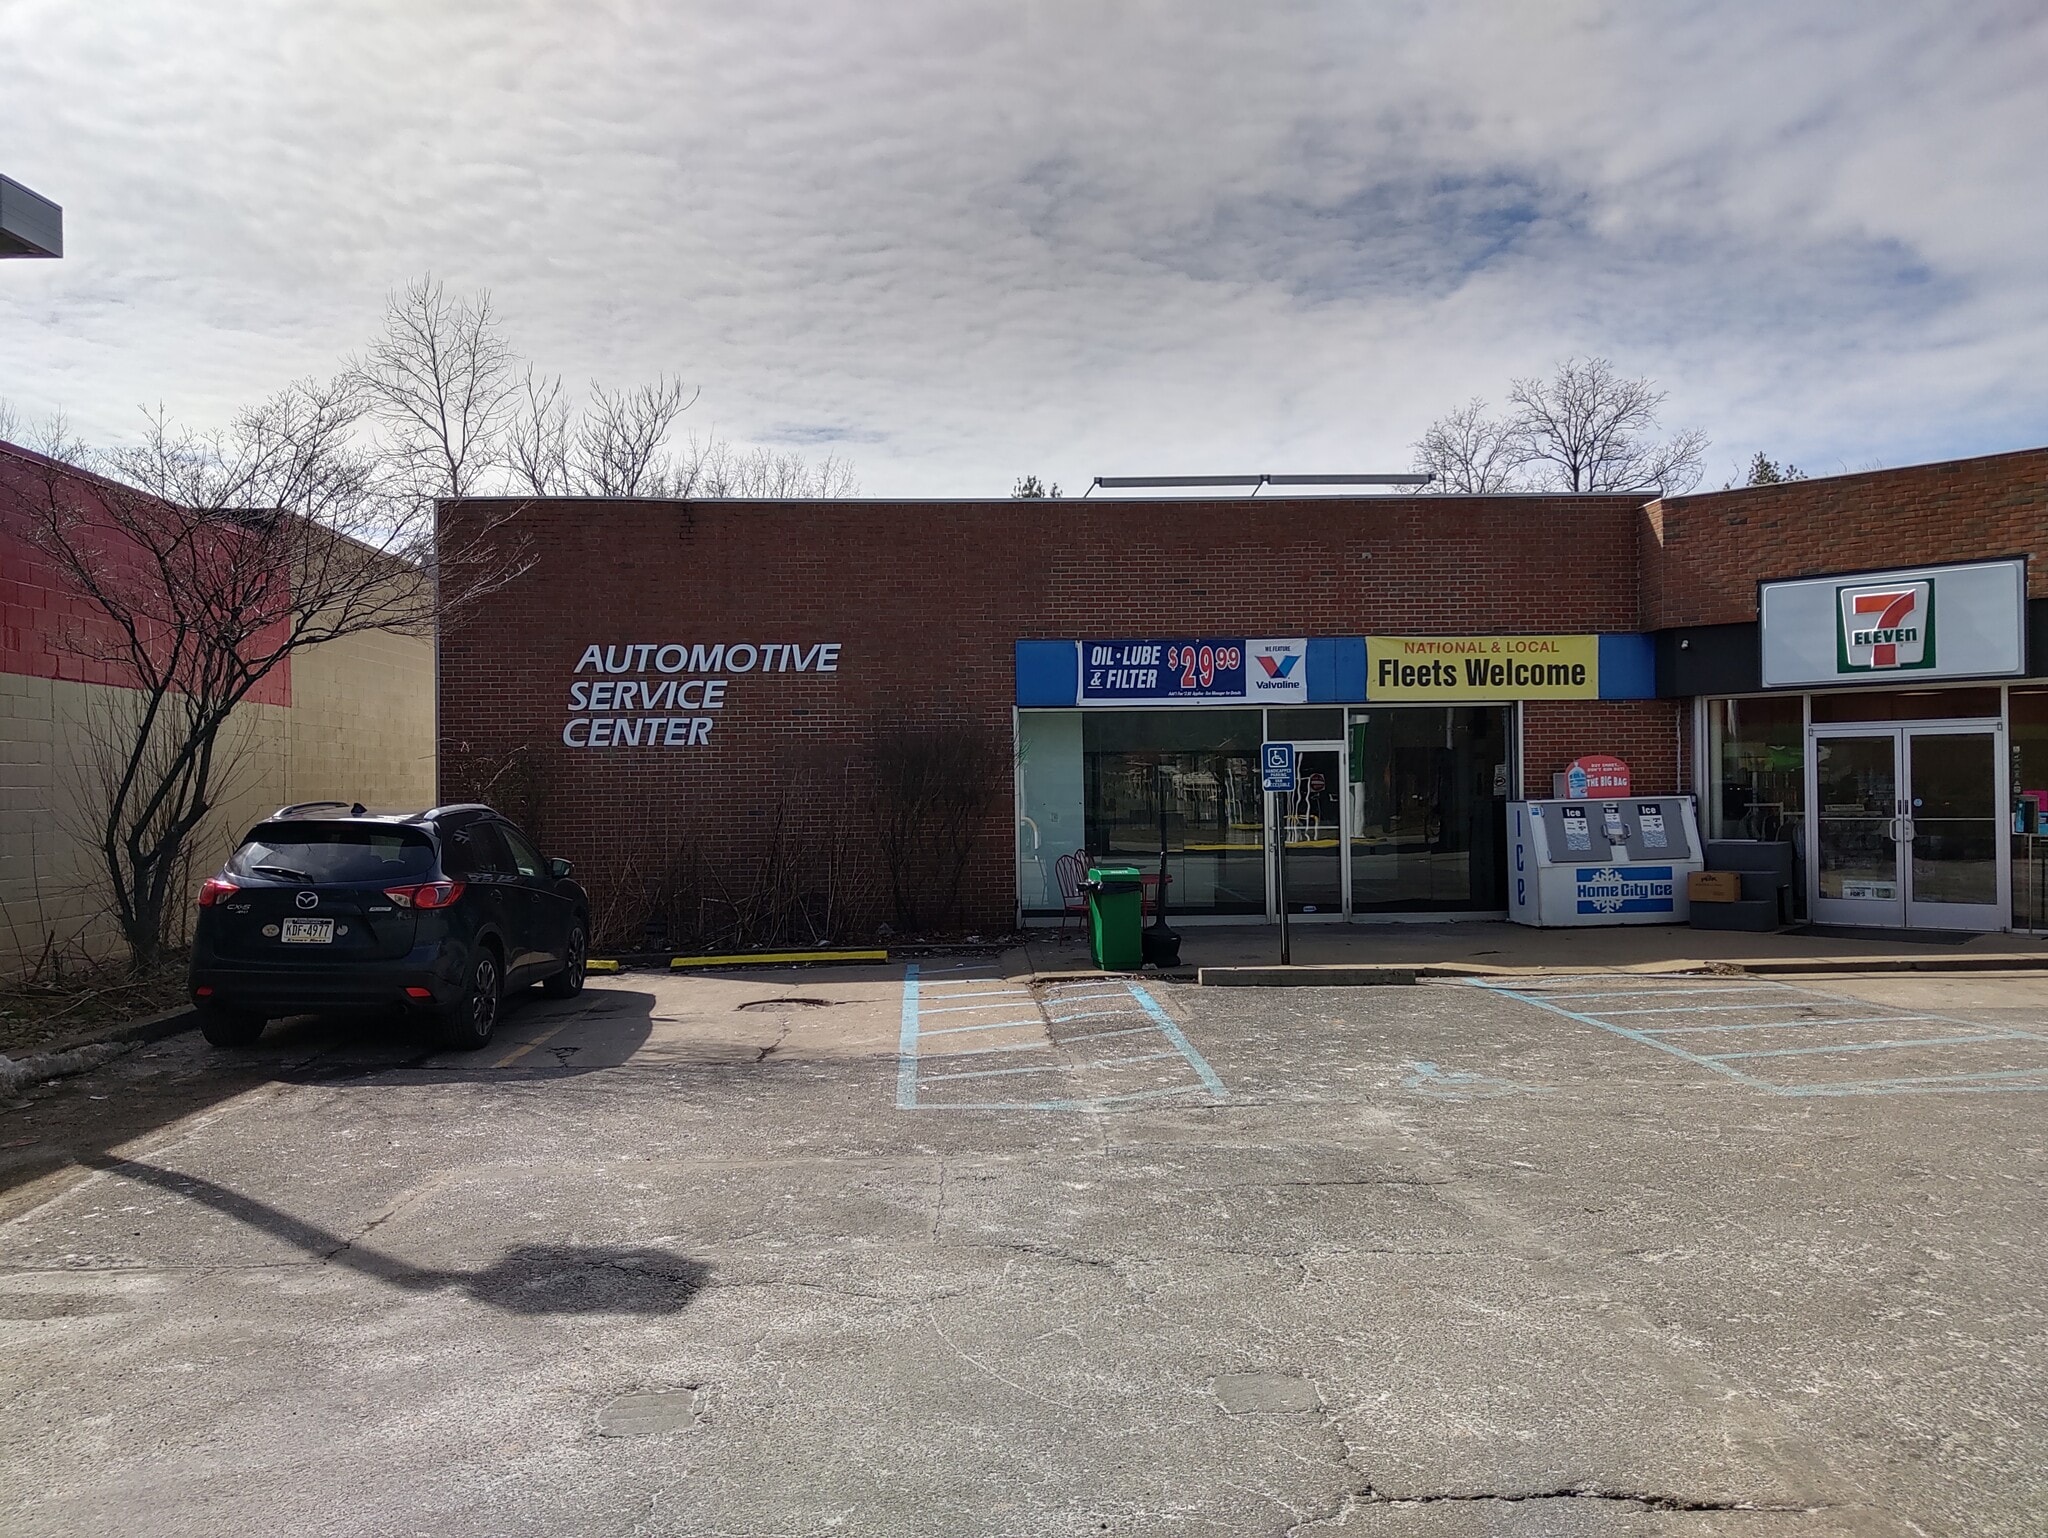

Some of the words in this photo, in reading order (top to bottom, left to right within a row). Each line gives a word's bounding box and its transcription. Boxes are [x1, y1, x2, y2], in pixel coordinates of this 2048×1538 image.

[1853, 588, 1917, 668] 7
[1404, 641, 1487, 654] NATIONAL
[1491, 641, 1501, 653] &
[1506, 640, 1560, 653] LOCAL
[573, 643, 842, 674] AUTOMOTIVE
[1090, 671, 1103, 687] &
[1106, 669, 1158, 689] FILTER
[1378, 659, 1458, 687] Fleets
[1464, 658, 1586, 686] Welcome
[1256, 681, 1300, 689] Valvoline
[567, 680, 729, 711] SERVICE
[562, 717, 714, 747] CENTER
[1587, 778, 1599, 787] THE
[1600, 775, 1613, 787] BIG
[1613, 776, 1628, 787] BAG
[1566, 808, 1581, 817] Ice
[1641, 806, 1657, 814] Ice
[1577, 884, 1619, 898] Home
[1621, 883, 1649, 899] City
[1650, 883, 1673, 896] Ice
